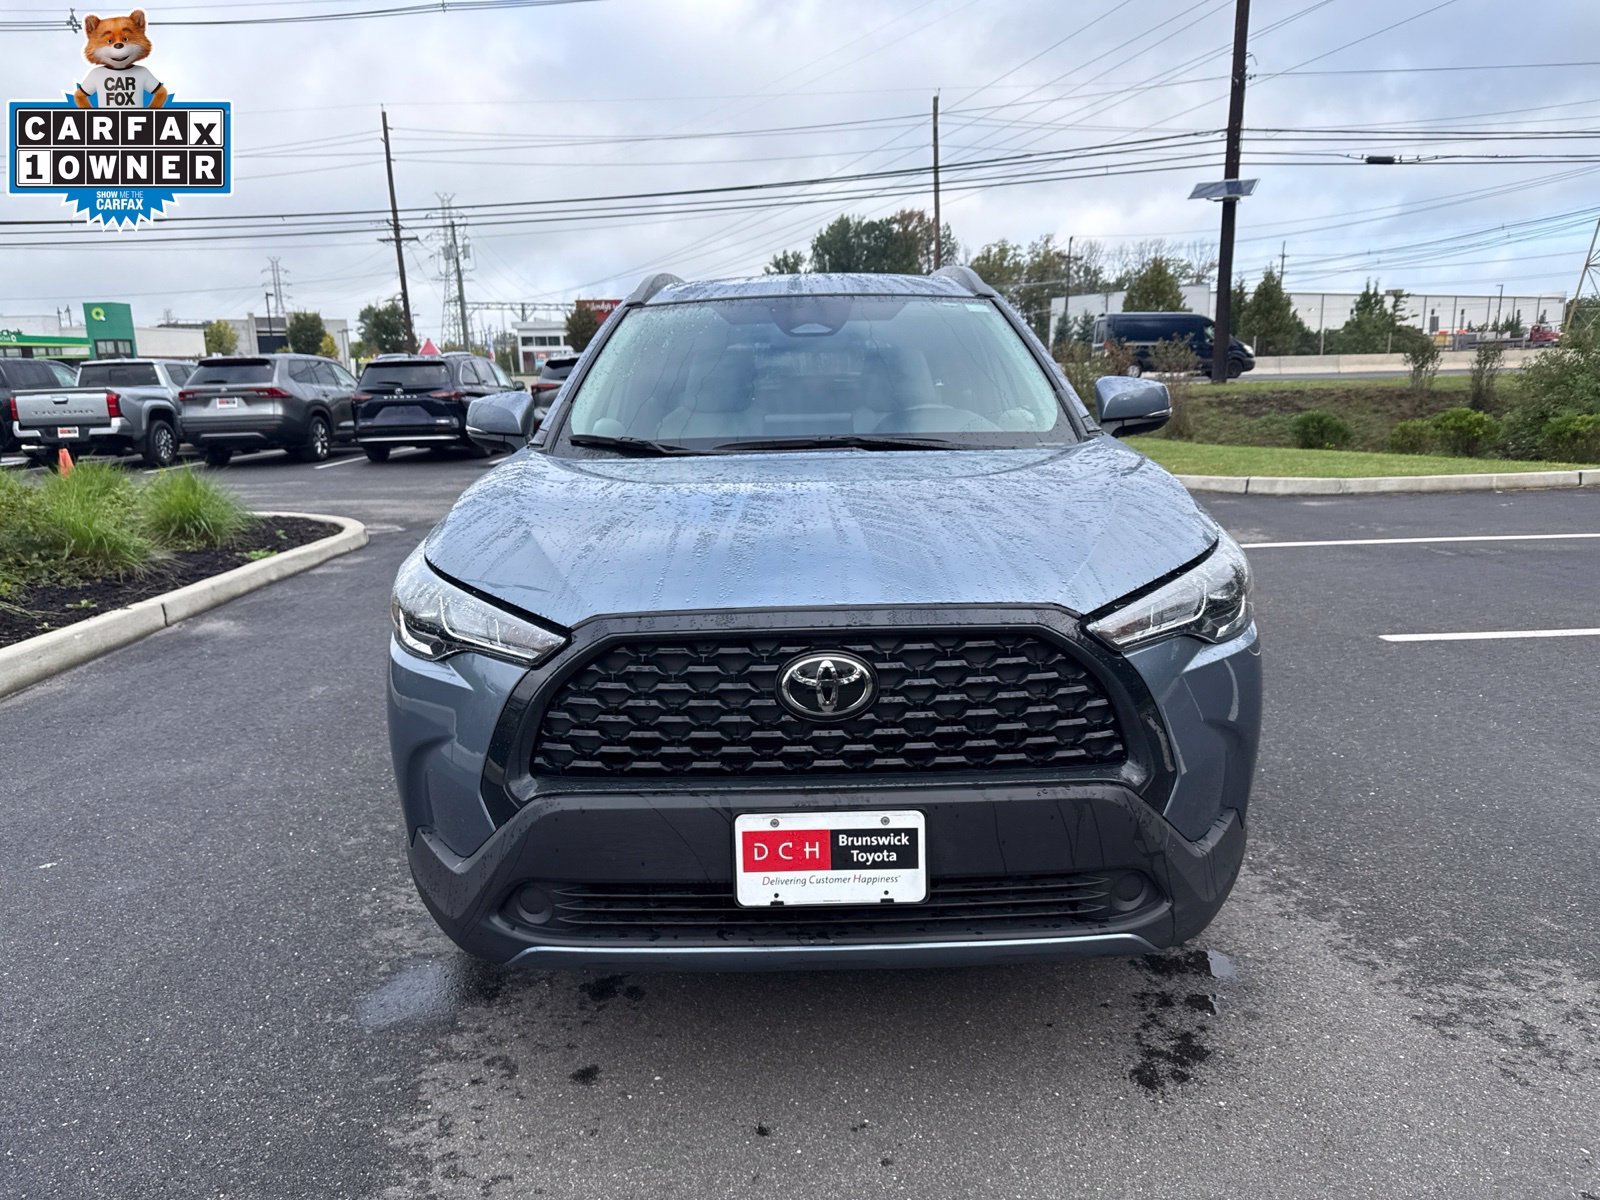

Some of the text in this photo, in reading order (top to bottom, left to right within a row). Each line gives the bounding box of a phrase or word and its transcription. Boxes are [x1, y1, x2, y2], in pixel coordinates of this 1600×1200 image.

[838, 832, 910, 847] Brunswick
[850, 849, 897, 866] Toyota
[762, 874, 899, 887] Delivering Customer Happiness
